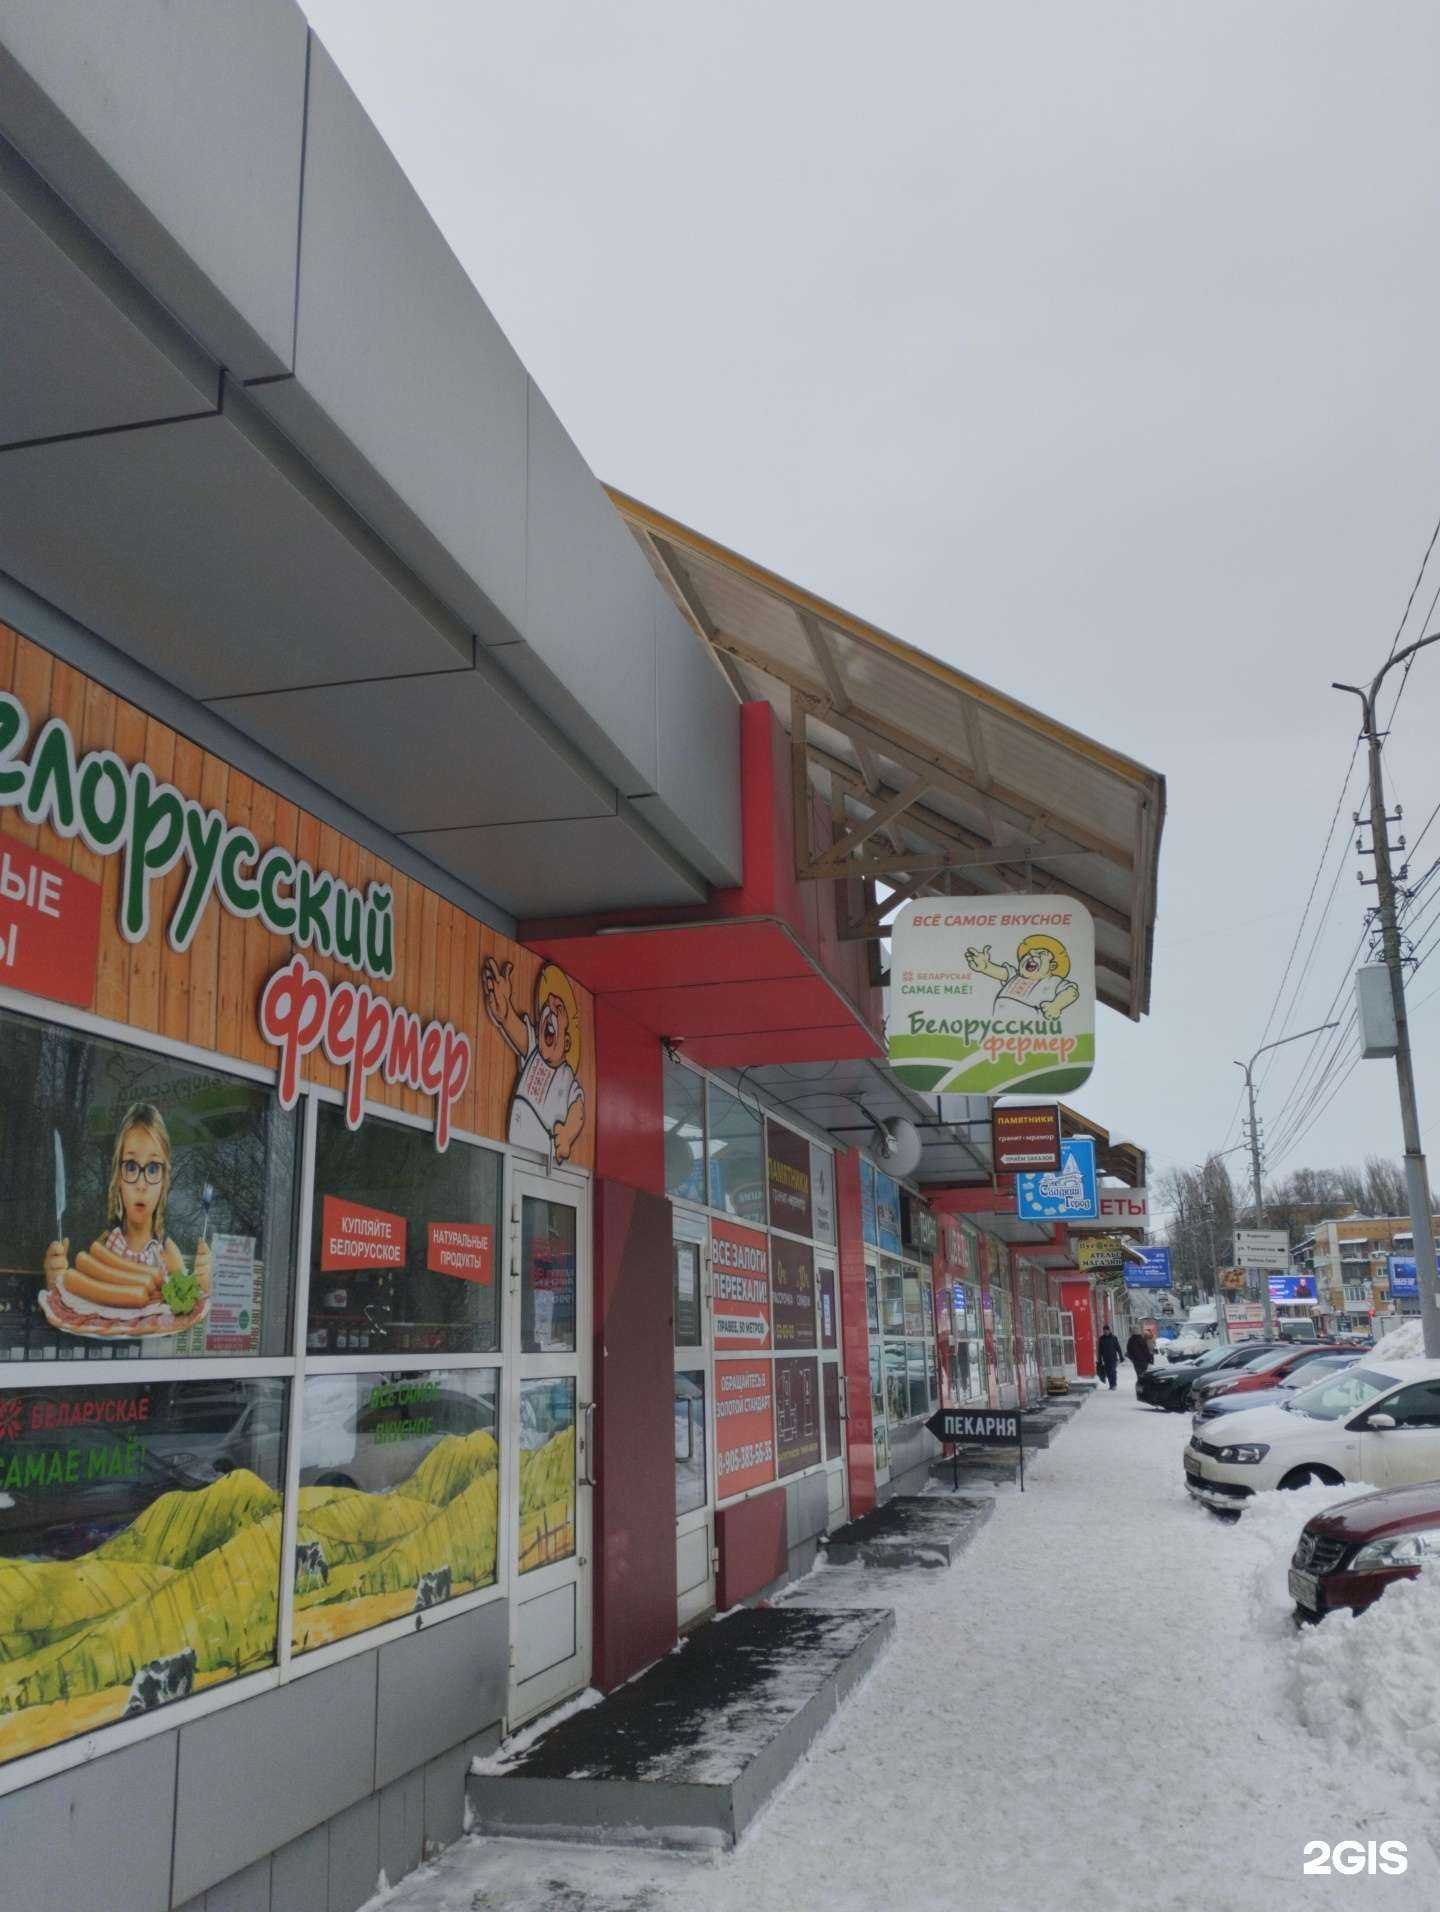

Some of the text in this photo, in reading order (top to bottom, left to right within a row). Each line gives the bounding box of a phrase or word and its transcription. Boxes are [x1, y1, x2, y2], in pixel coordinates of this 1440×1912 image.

[912, 913, 1073, 927] ВСЁ САМОЕ ВКУСНОЕ
[917, 972, 973, 981] БЕЛАРУСКАЕ
[901, 983, 974, 995] САМАЕ МАЁ!
[908, 1010, 1063, 1046] Белорусский
[263, 957, 470, 1151] фермер
[982, 1035, 1076, 1063] фермер
[997, 1115, 1055, 1125] ПАМЯТНИКИ
[341, 1216, 393, 1240] КУПЛЯЙТЕ
[432, 1228, 489, 1251] НАТУРАЛЬНЫЕ
[330, 1237, 401, 1262] БЕЛОРУССКОЕ
[440, 1250, 481, 1269] ПРОДУКТЫ
[712, 1238, 731, 1266] ВСЕ
[31, 1396, 150, 1431] БЕЛАРУСКАЕ
[944, 1415, 1017, 1437] ПЕКАРНЯ
